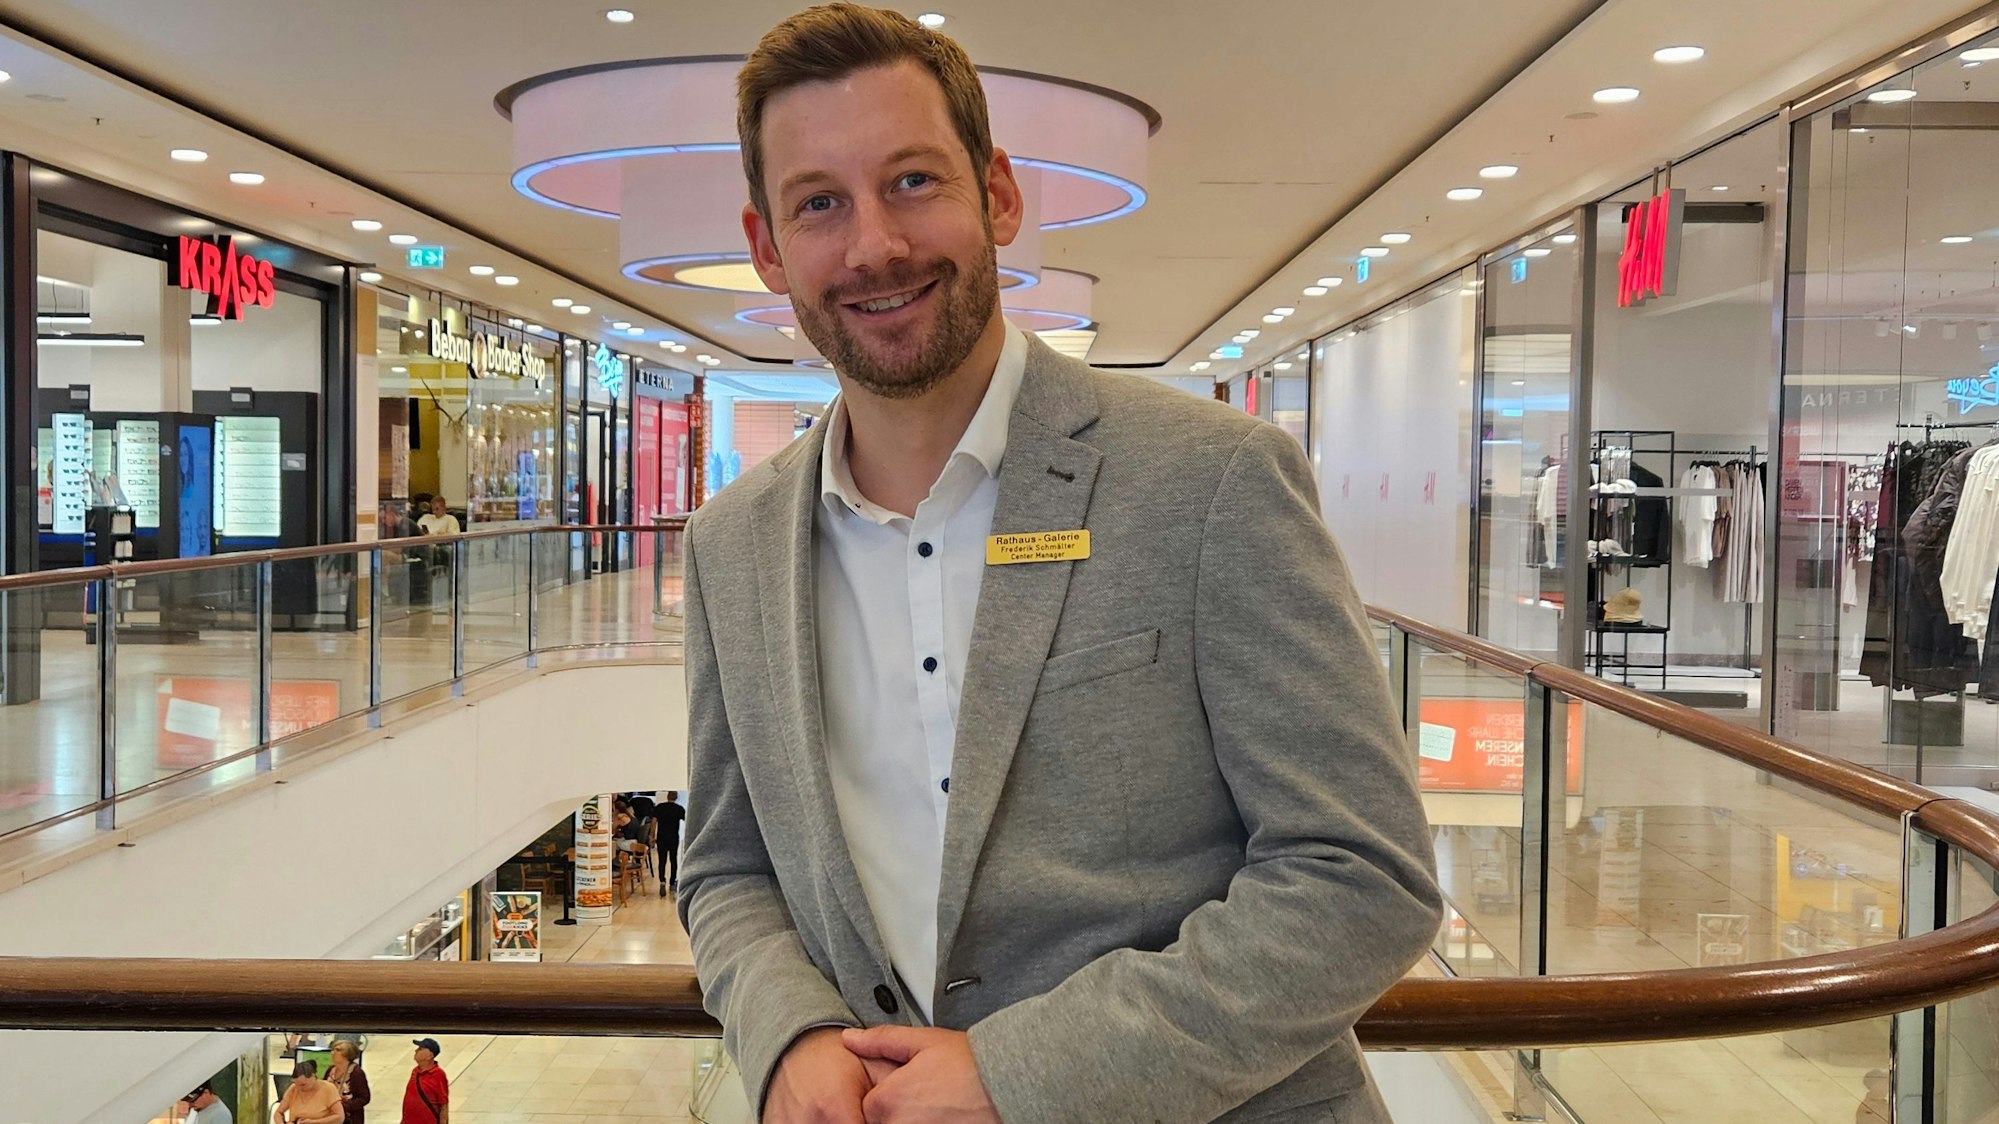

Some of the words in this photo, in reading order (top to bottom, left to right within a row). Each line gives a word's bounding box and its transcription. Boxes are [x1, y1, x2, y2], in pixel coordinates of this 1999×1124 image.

[180, 235, 274, 322] KRASS
[431, 317, 471, 364] Beban
[638, 368, 674, 391] ETERNA
[996, 536, 1037, 545] Rathaus
[1043, 533, 1080, 542] Galerie
[1000, 545, 1034, 553] Frederik
[1035, 551, 1065, 560] Manager
